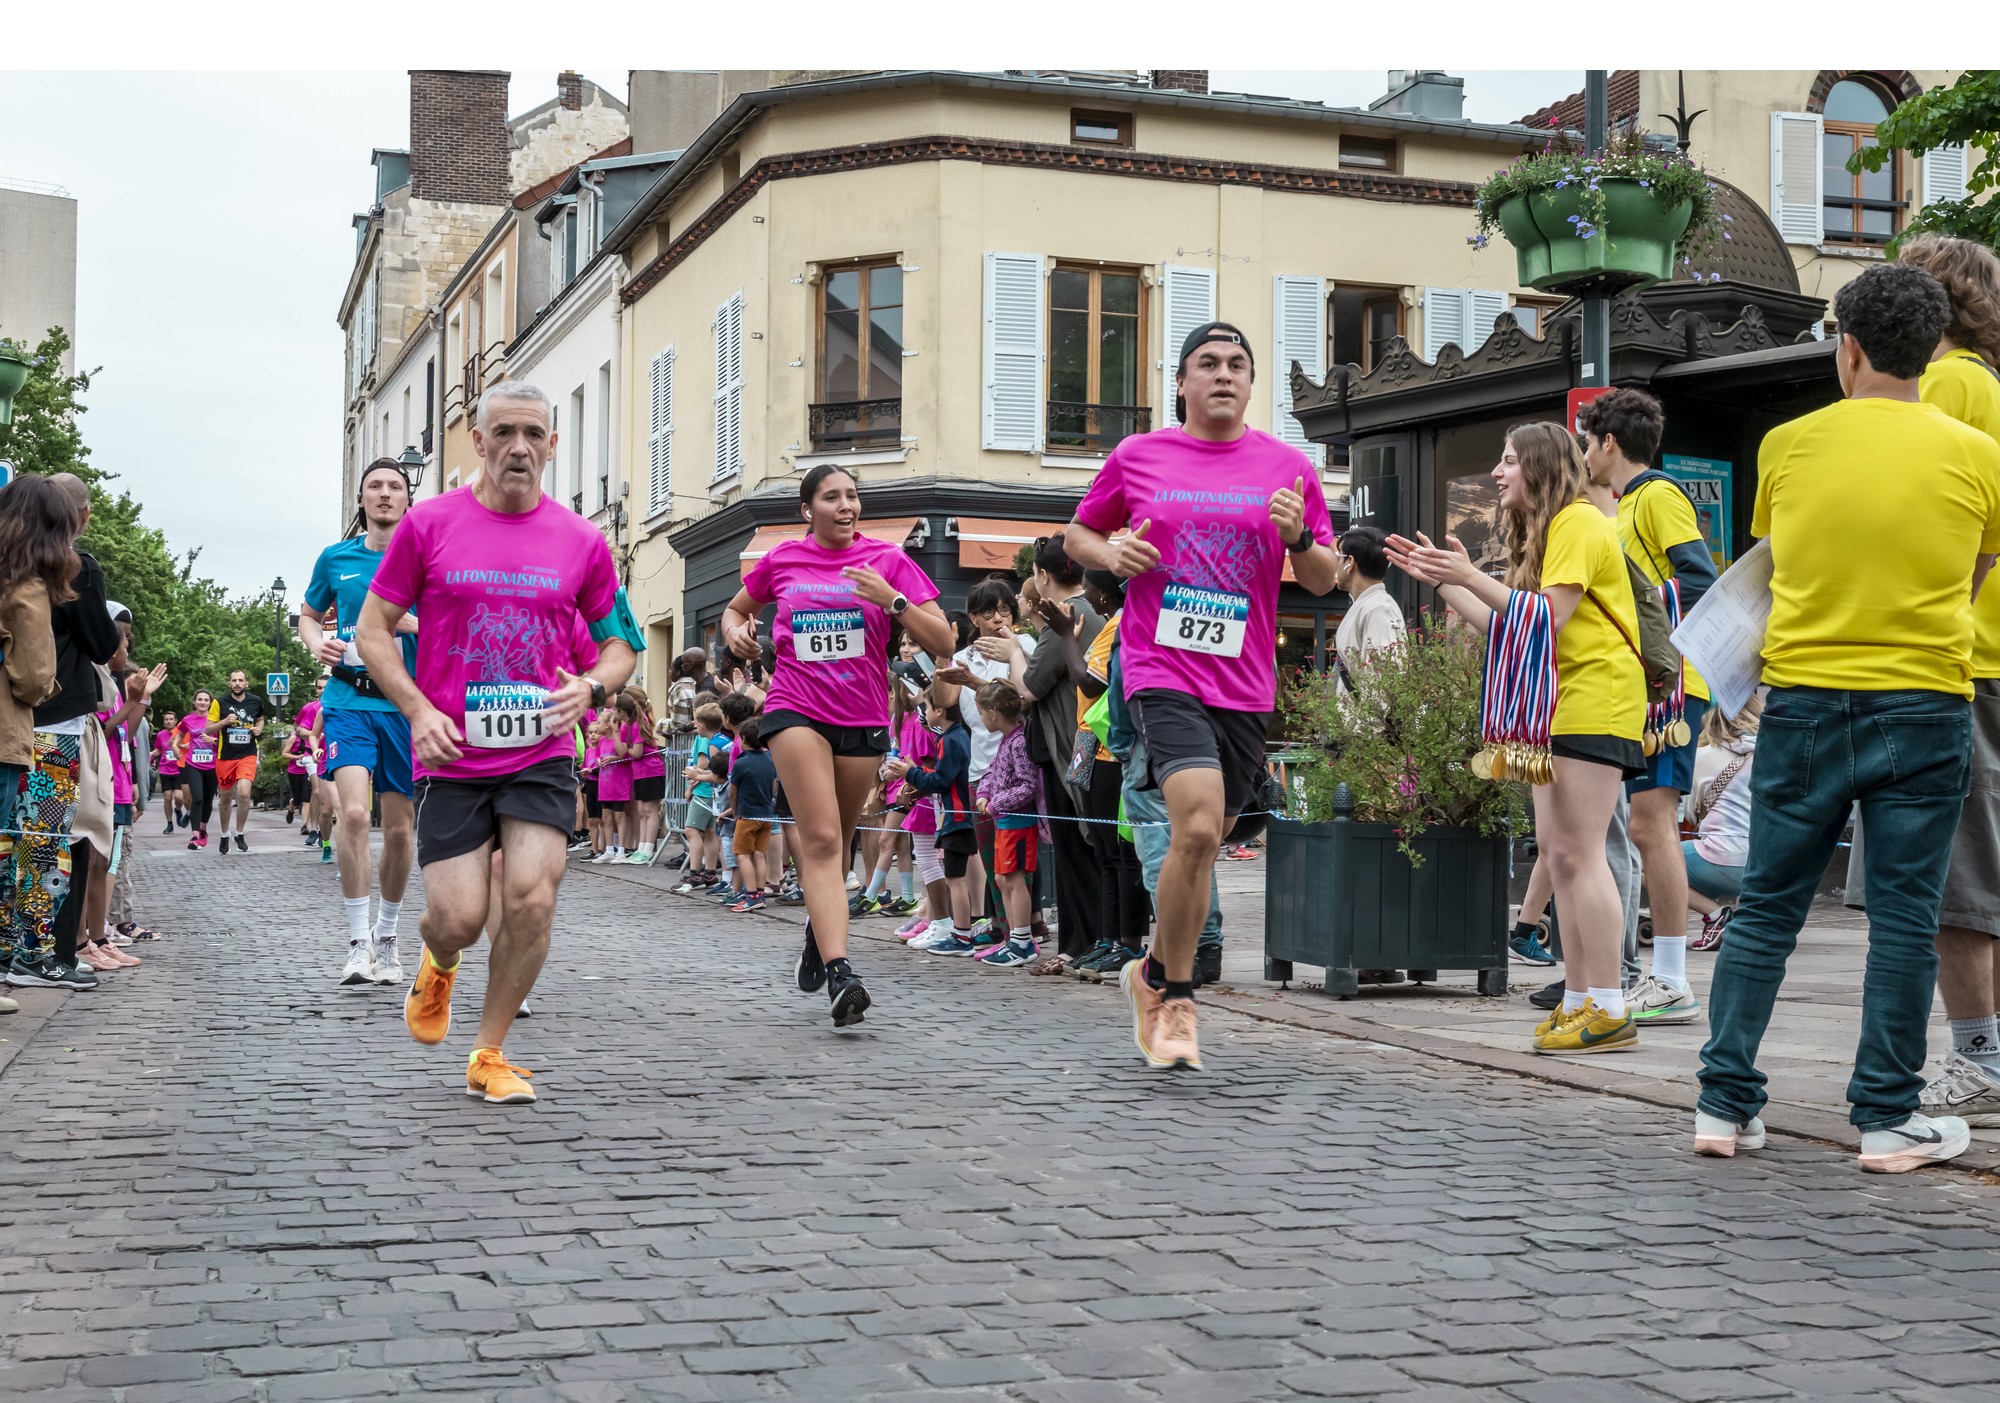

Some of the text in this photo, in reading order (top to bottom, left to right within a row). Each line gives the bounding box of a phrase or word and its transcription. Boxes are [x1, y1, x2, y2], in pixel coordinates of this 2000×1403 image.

[1154, 490, 1268, 507] LA FONTENAISIENNE
[446, 569, 562, 591] LA FONTENAISIENNE
[496, 587, 514, 596] JUIN
[1164, 585, 1248, 608] LA FONTENAISIENNE
[793, 611, 862, 622] LA FONTENAISIENNE
[1178, 616, 1226, 645] 873
[810, 634, 848, 653] 615
[1188, 643, 1211, 651] ADRIAN
[466, 685, 478, 697] LA
[481, 713, 542, 738] 1011
[219, 776, 233, 786] 26
